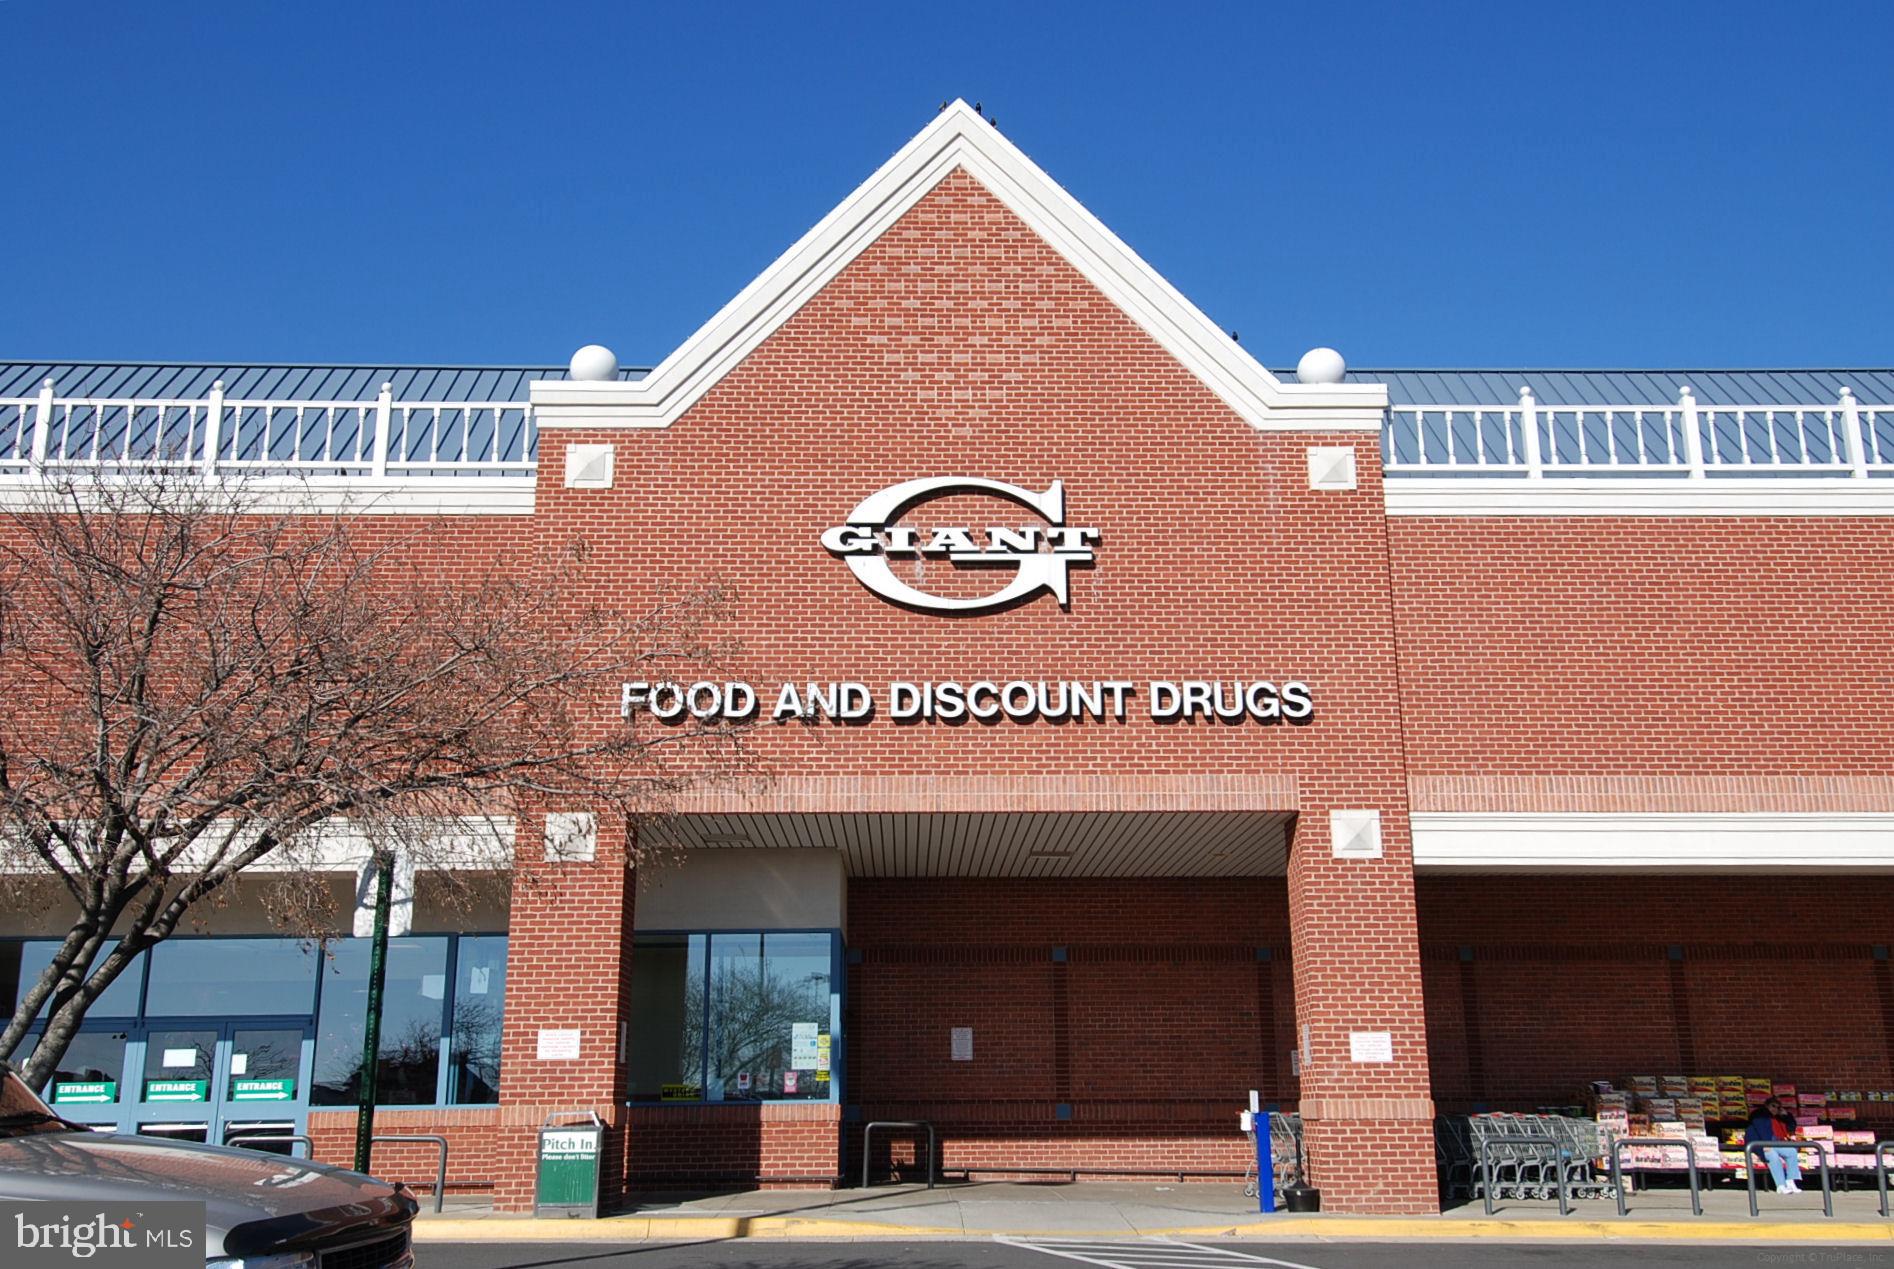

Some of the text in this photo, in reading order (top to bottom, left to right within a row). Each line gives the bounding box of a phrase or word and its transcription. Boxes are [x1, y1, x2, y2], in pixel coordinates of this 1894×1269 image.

[820, 526, 1099, 552] GIANT
[620, 681, 1313, 718] FOOD AND DISCOUNT DRUGS
[58, 1084, 106, 1094] ENTRANCE
[149, 1083, 197, 1092] ENTRANCE
[236, 1081, 284, 1091] ENTRANCE
[542, 1137, 576, 1150] Pitch
[542, 1153, 563, 1161] Please
